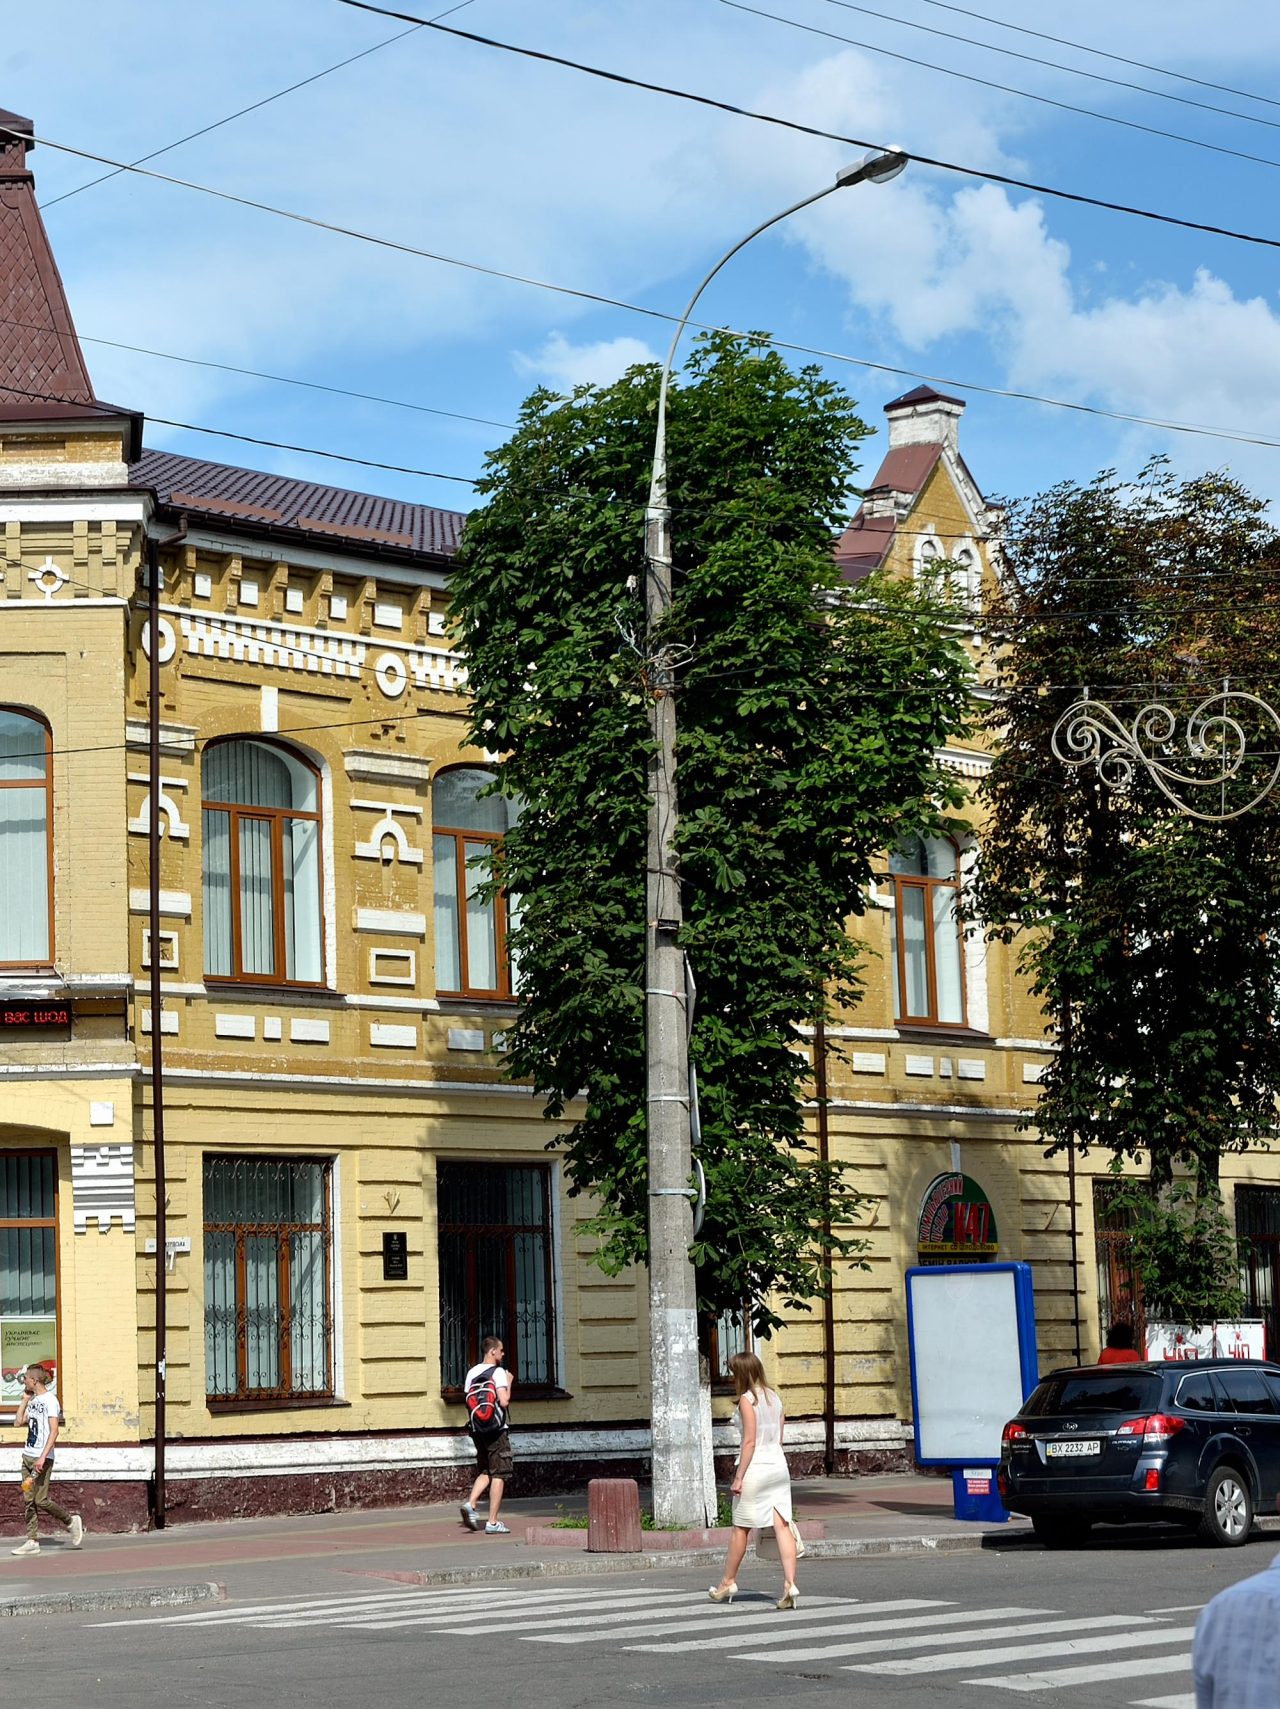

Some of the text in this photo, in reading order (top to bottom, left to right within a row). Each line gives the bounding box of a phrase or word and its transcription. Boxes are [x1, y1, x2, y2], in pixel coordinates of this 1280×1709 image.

[1051, 1440, 1099, 1454] BX 2232 AP
